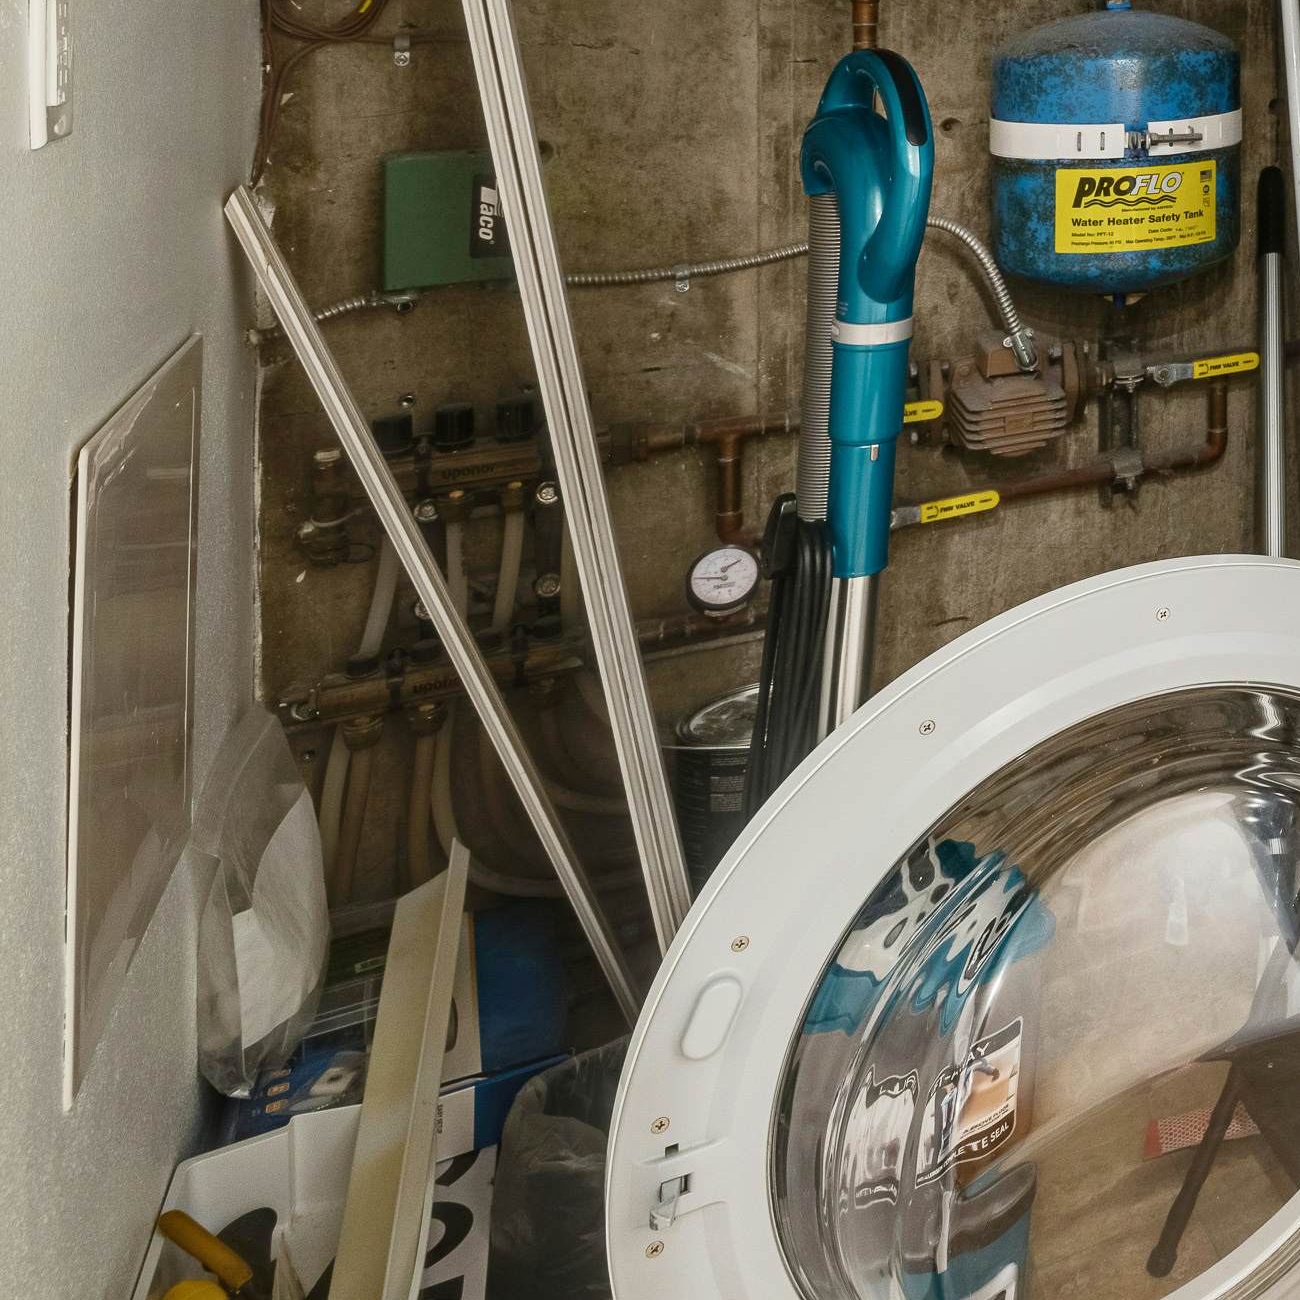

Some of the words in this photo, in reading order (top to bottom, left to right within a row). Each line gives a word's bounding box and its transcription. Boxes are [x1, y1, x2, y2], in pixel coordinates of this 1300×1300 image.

[1072, 172, 1184, 208] PROFLO
[1072, 218, 1104, 227] Water
[1107, 216, 1145, 226] Heater
[1148, 213, 1181, 223] Safety
[1184, 209, 1204, 220] Tank
[955, 501, 975, 510] VALVE
[990, 1121, 1010, 1143] SEAL
